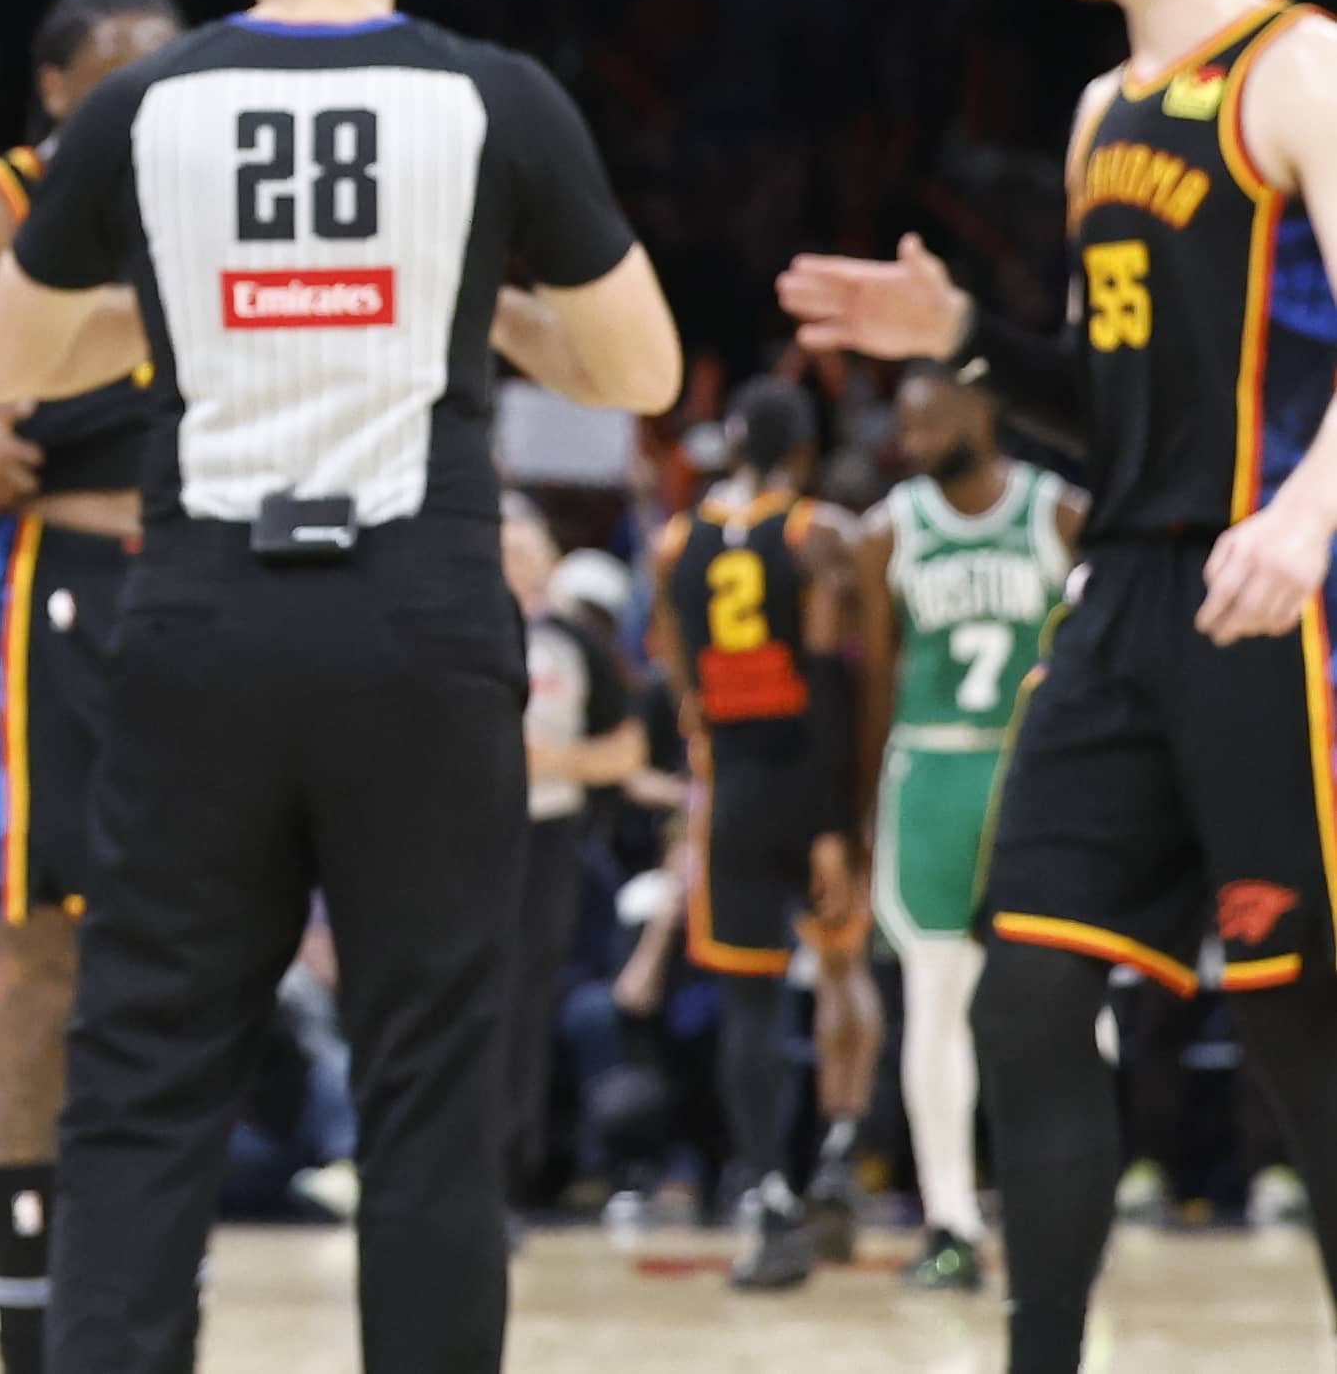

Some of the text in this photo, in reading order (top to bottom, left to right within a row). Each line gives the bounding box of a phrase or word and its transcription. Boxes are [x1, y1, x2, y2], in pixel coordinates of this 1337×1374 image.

[236, 107, 378, 242] 28
[232, 278, 384, 320] Emirates
[1082, 239, 1154, 354] 55
[706, 548, 770, 654] 2
[948, 621, 1016, 714] 7
